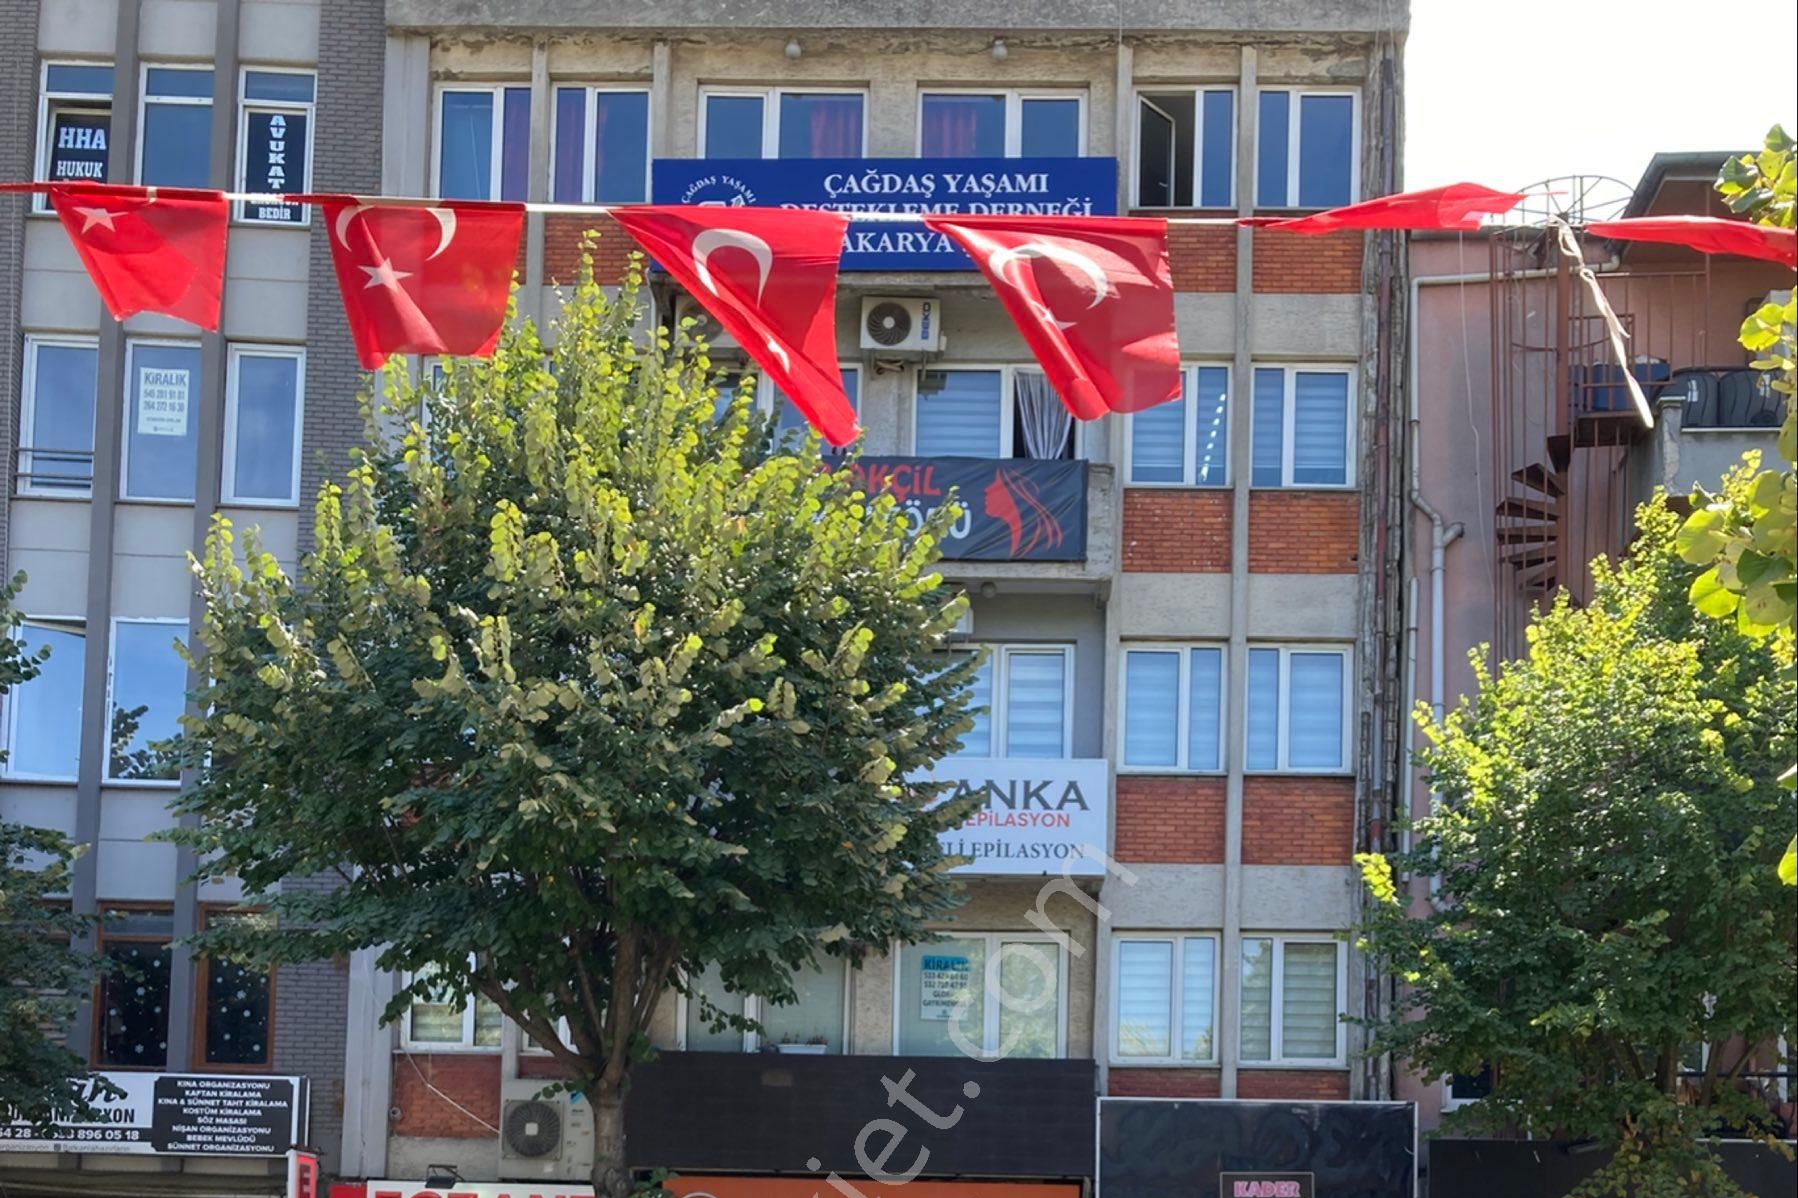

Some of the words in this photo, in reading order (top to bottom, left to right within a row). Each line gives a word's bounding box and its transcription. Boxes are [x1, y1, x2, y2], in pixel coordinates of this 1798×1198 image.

[58, 127, 107, 150] HHA
[267, 115, 287, 189] AVUKAT
[56, 160, 103, 178] HUKUK
[823, 168, 936, 199] ÇAĞDAŞ
[942, 173, 1049, 199] YAŞAMI
[258, 205, 291, 220] BEDİR
[842, 232, 955, 253] AKARYA
[970, 838, 1086, 861] EPİLASYON
[177, 1080, 197, 1088] KINA
[199, 1080, 271, 1089] ORGANİZASYONU
[184, 1089, 218, 1098] KAFTAN
[219, 1090, 263, 1099] KİRALAMA
[157, 1097, 178, 1105] KINA
[187, 1097, 221, 1107] SÜNNET
[222, 1100, 244, 1108] TAHT
[245, 1099, 289, 1108] KİRALAMA
[182, 1106, 219, 1115] KOSTÜM
[219, 1107, 263, 1117] KİRALAMA
[197, 1115, 214, 1124] SÖZ
[215, 1117, 248, 1125] MASASI
[15, 1128, 32, 1139] 28
[77, 1129, 102, 1140] 896
[105, 1130, 122, 1140] 05
[125, 1130, 140, 1141] 18
[172, 1124, 199, 1134] NİŞAN
[199, 1124, 272, 1135] ORGANİZASYONU
[186, 1134, 213, 1142] BEBEK
[214, 1134, 256, 1143] MEVLÜDÜ
[167, 1142, 201, 1151] SÜNNET
[201, 1143, 275, 1153] ORGANİZASYONU
[1233, 1181, 1301, 1198] KADER
